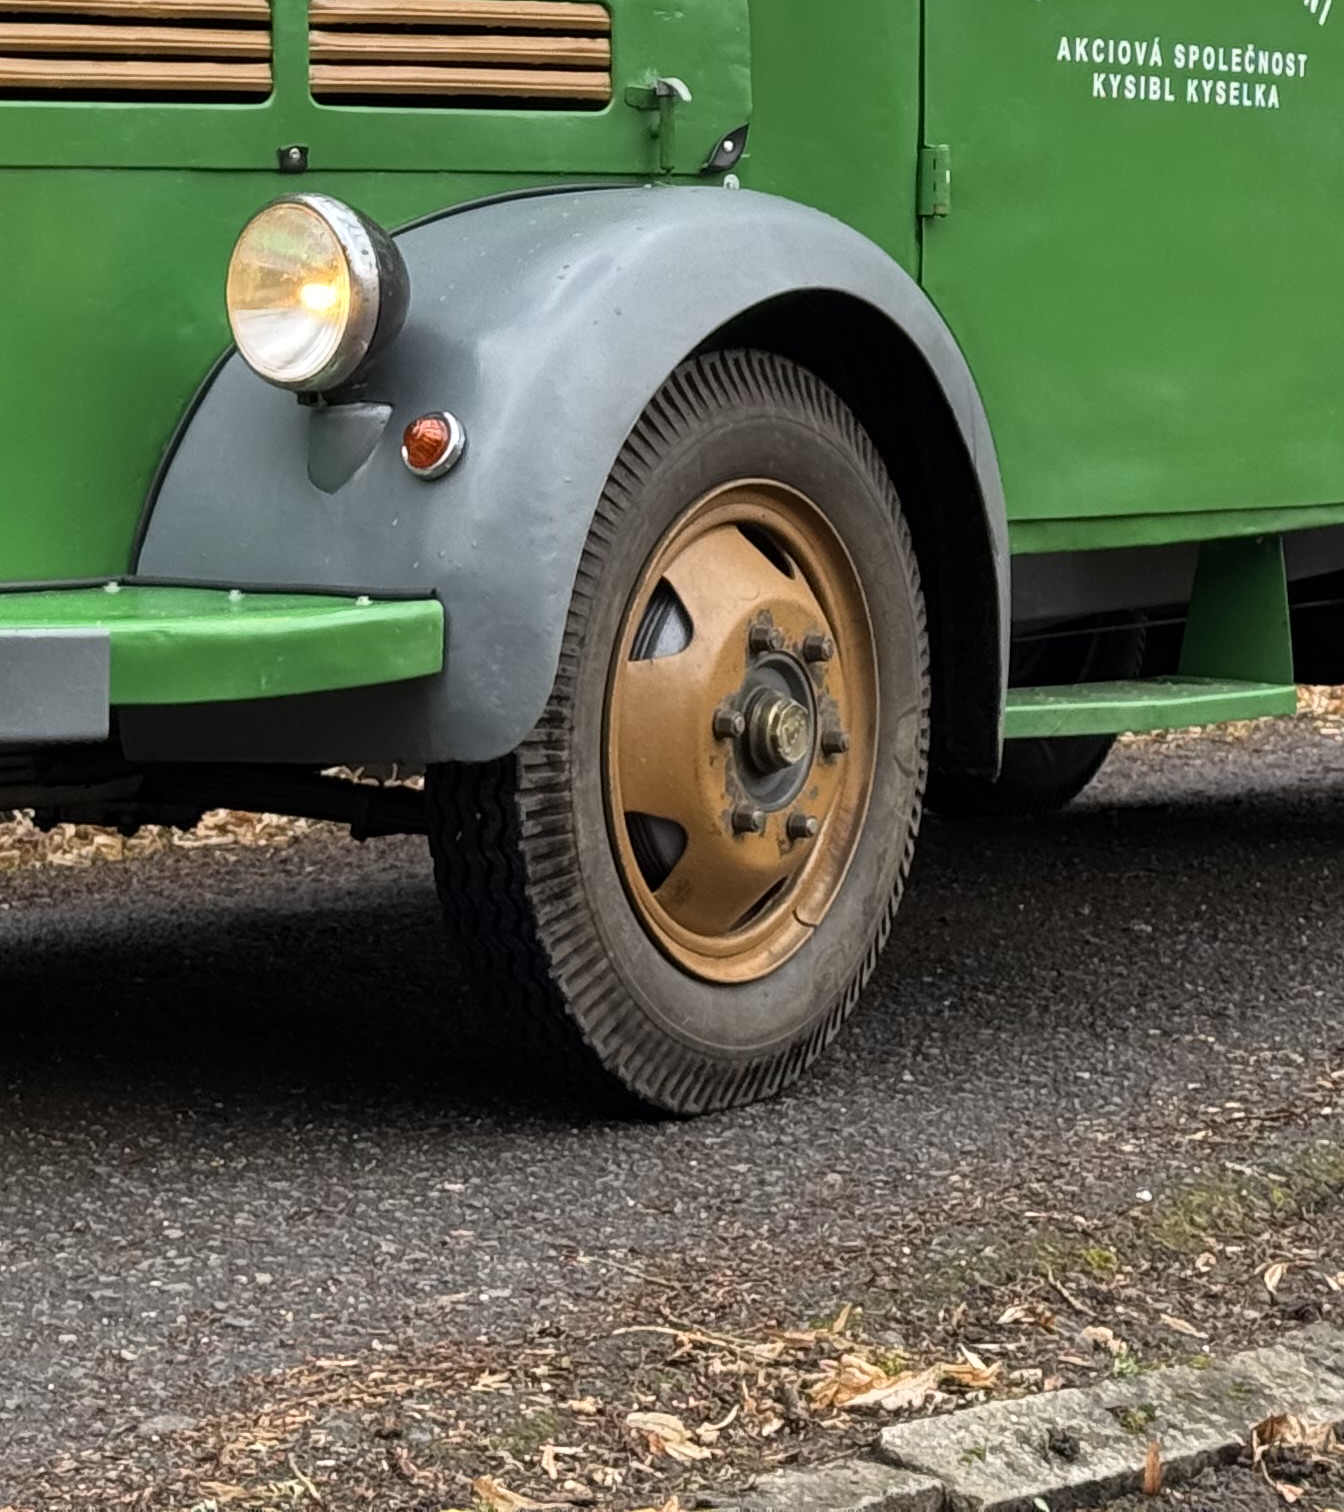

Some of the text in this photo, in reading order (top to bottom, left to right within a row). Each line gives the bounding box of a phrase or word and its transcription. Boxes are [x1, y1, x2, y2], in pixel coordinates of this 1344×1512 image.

[1056, 36, 1308, 78] AKCIOVÁ SPOLEČNOST
[1092, 72, 1280, 109] KYSIBL KYSELKA
